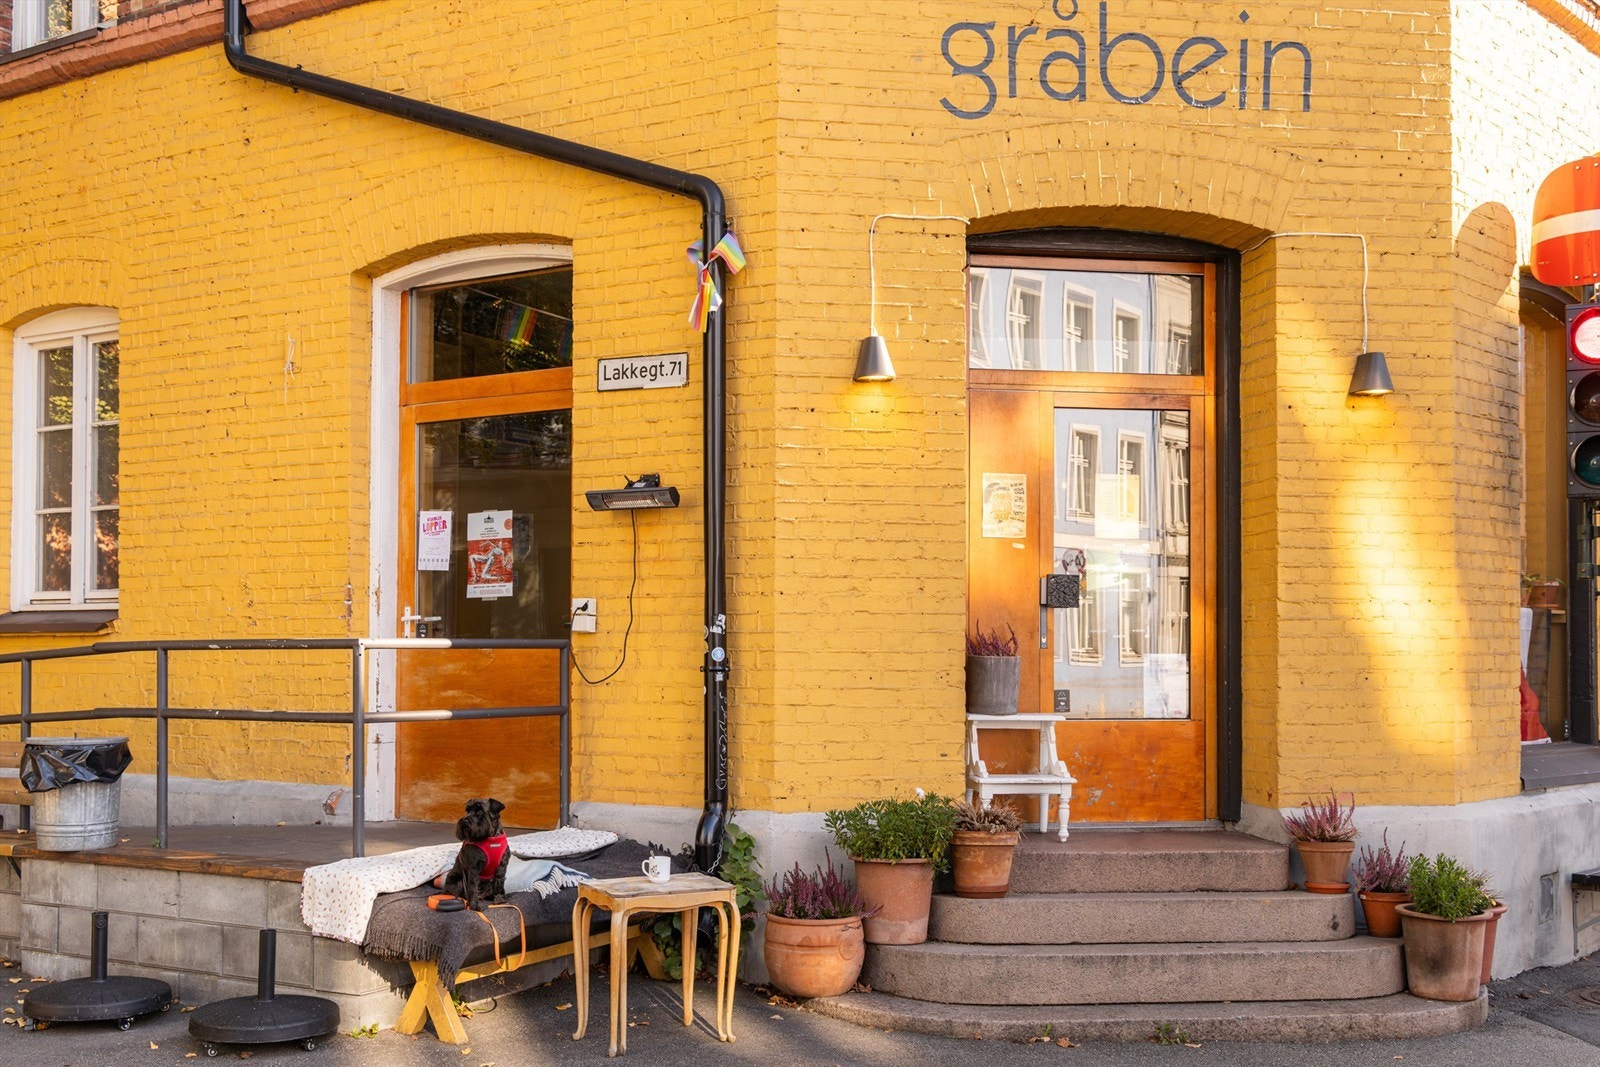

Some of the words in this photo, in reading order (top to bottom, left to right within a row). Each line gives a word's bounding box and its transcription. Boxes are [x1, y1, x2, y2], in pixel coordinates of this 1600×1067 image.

[939, 0, 1312, 120] gråbein
[603, 360, 682, 382] Lakkegt.71
[422, 520, 448, 533] LOPPER
